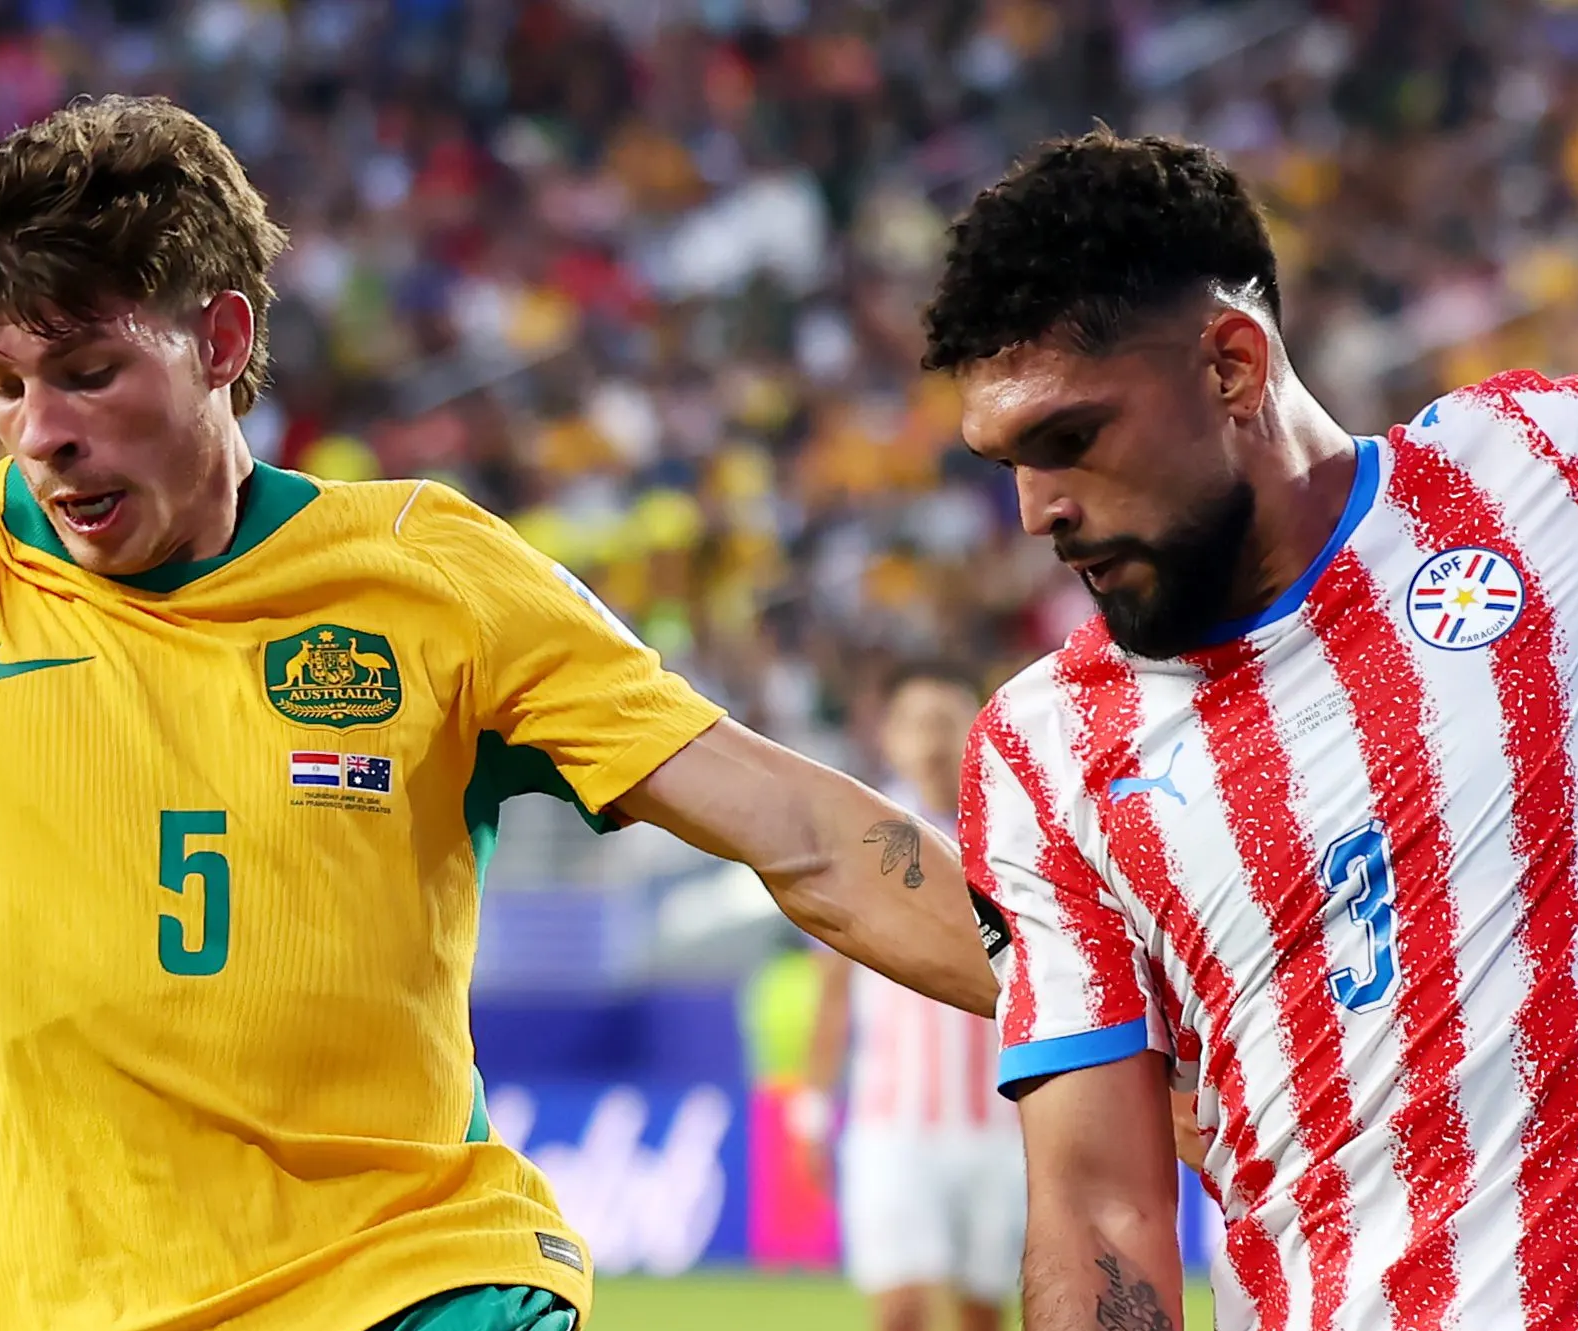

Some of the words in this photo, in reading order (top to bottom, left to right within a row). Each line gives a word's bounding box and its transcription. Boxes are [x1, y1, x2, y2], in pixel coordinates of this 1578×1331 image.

[1429, 555, 1463, 586] APF
[1459, 615, 1509, 644] PARAGUAY
[289, 688, 382, 701] AUSTRALIA
[1296, 711, 1321, 729] JUNIO
[157, 809, 231, 977] 5
[1321, 818, 1403, 1015] 3
